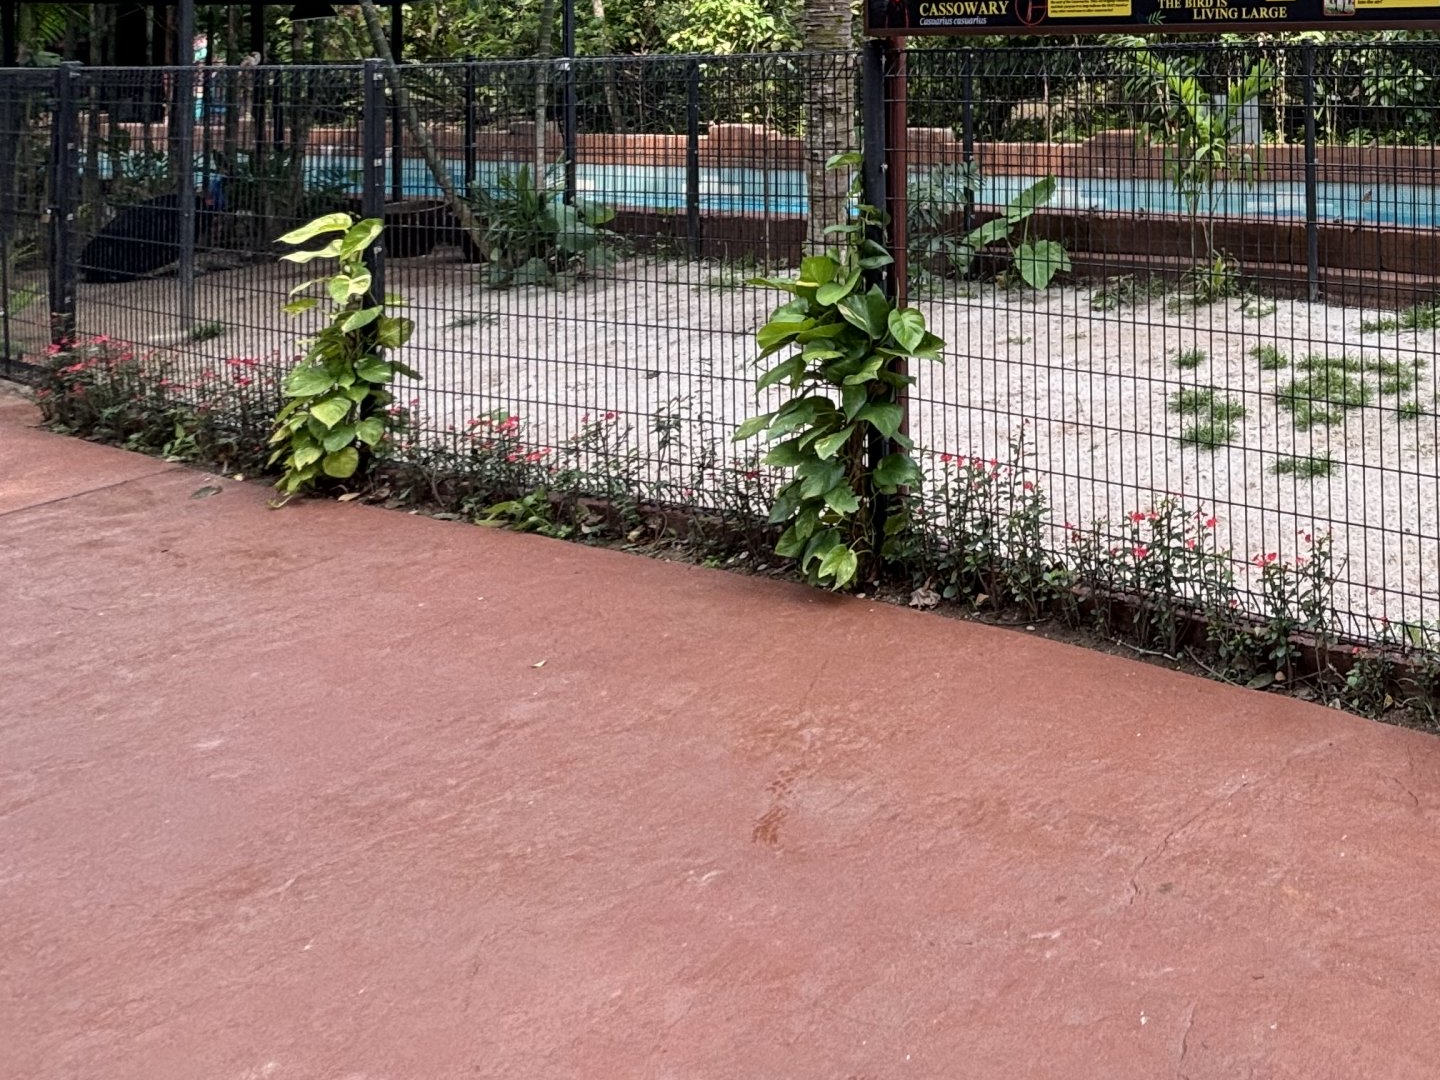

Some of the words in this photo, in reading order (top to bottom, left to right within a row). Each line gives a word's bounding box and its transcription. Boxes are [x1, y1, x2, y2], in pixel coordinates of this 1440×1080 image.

[920, 1, 1009, 16] CASSOWARY
[1193, 8, 1238, 20] LIVING
[1242, 7, 1287, 18] LARGE
[920, 17, 952, 25] Casuarius
[954, 16, 986, 24] casuarius
